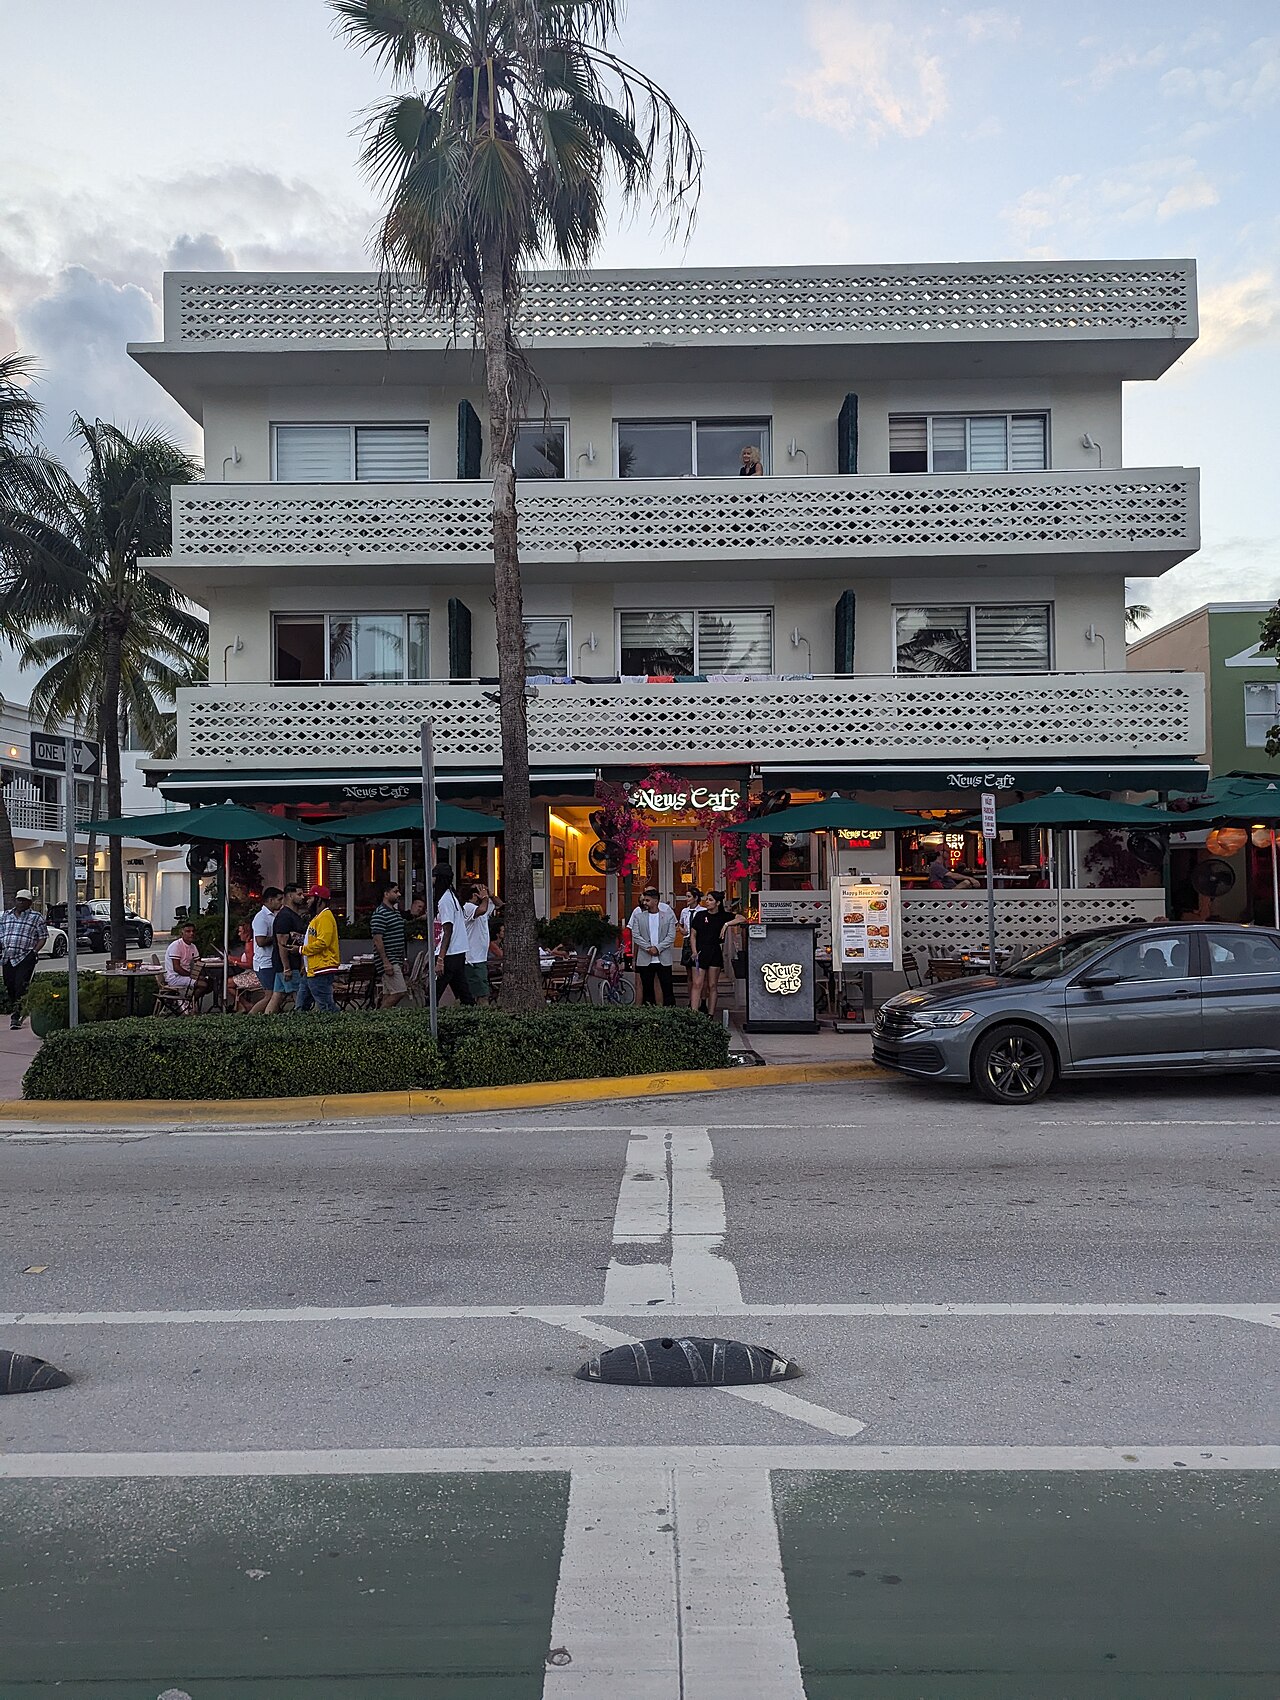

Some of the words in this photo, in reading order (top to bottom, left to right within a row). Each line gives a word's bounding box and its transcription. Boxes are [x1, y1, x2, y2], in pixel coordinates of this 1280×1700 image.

[38, 744, 59, 760] ONE
[947, 773, 983, 788] News
[984, 773, 1016, 789] Cafe
[342, 786, 378, 799] News
[379, 785, 410, 799] Cafe
[633, 788, 687, 811] News
[690, 787, 741, 811] Cafe
[837, 829, 861, 839] News
[945, 833, 964, 842] ESH
[849, 839, 871, 848] BAR
[762, 964, 801, 979] News
[765, 976, 800, 993] Cafe
